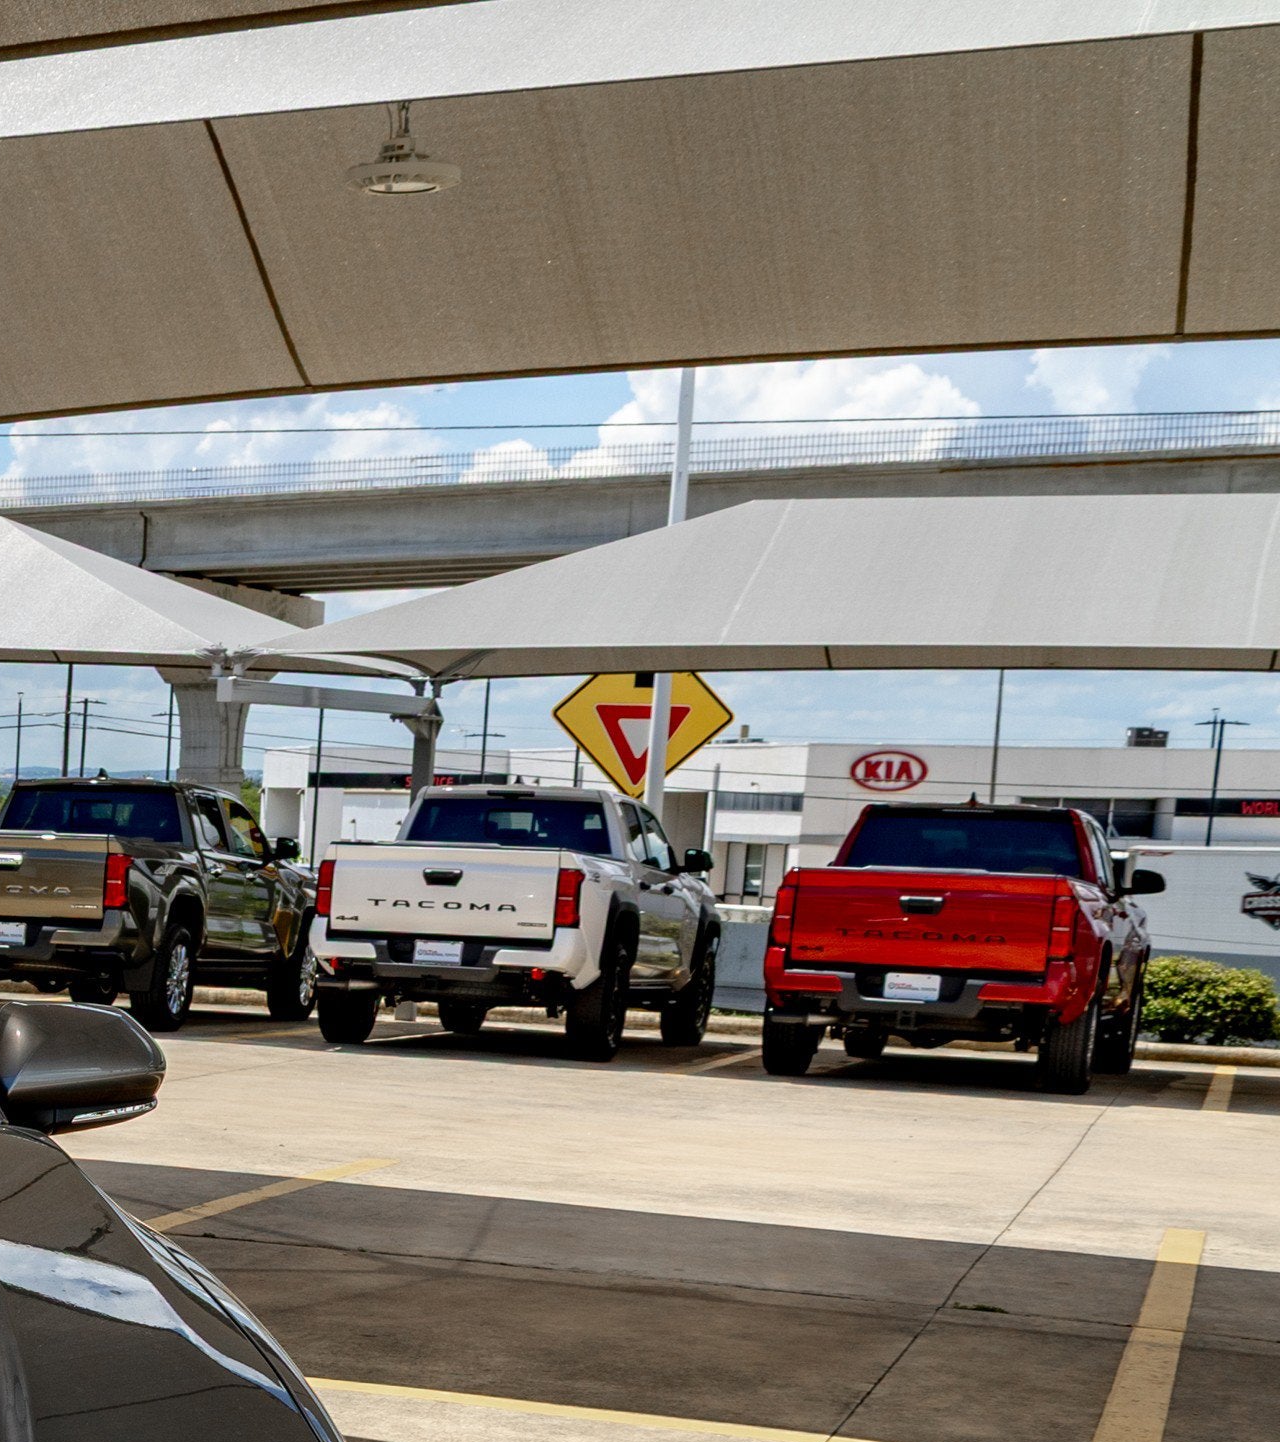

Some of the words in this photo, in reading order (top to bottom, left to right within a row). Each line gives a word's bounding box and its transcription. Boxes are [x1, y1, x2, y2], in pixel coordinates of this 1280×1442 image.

[864, 760, 914, 782] KIA
[367, 898, 517, 912] TACOMA
[836, 928, 1006, 943] TACOMA
